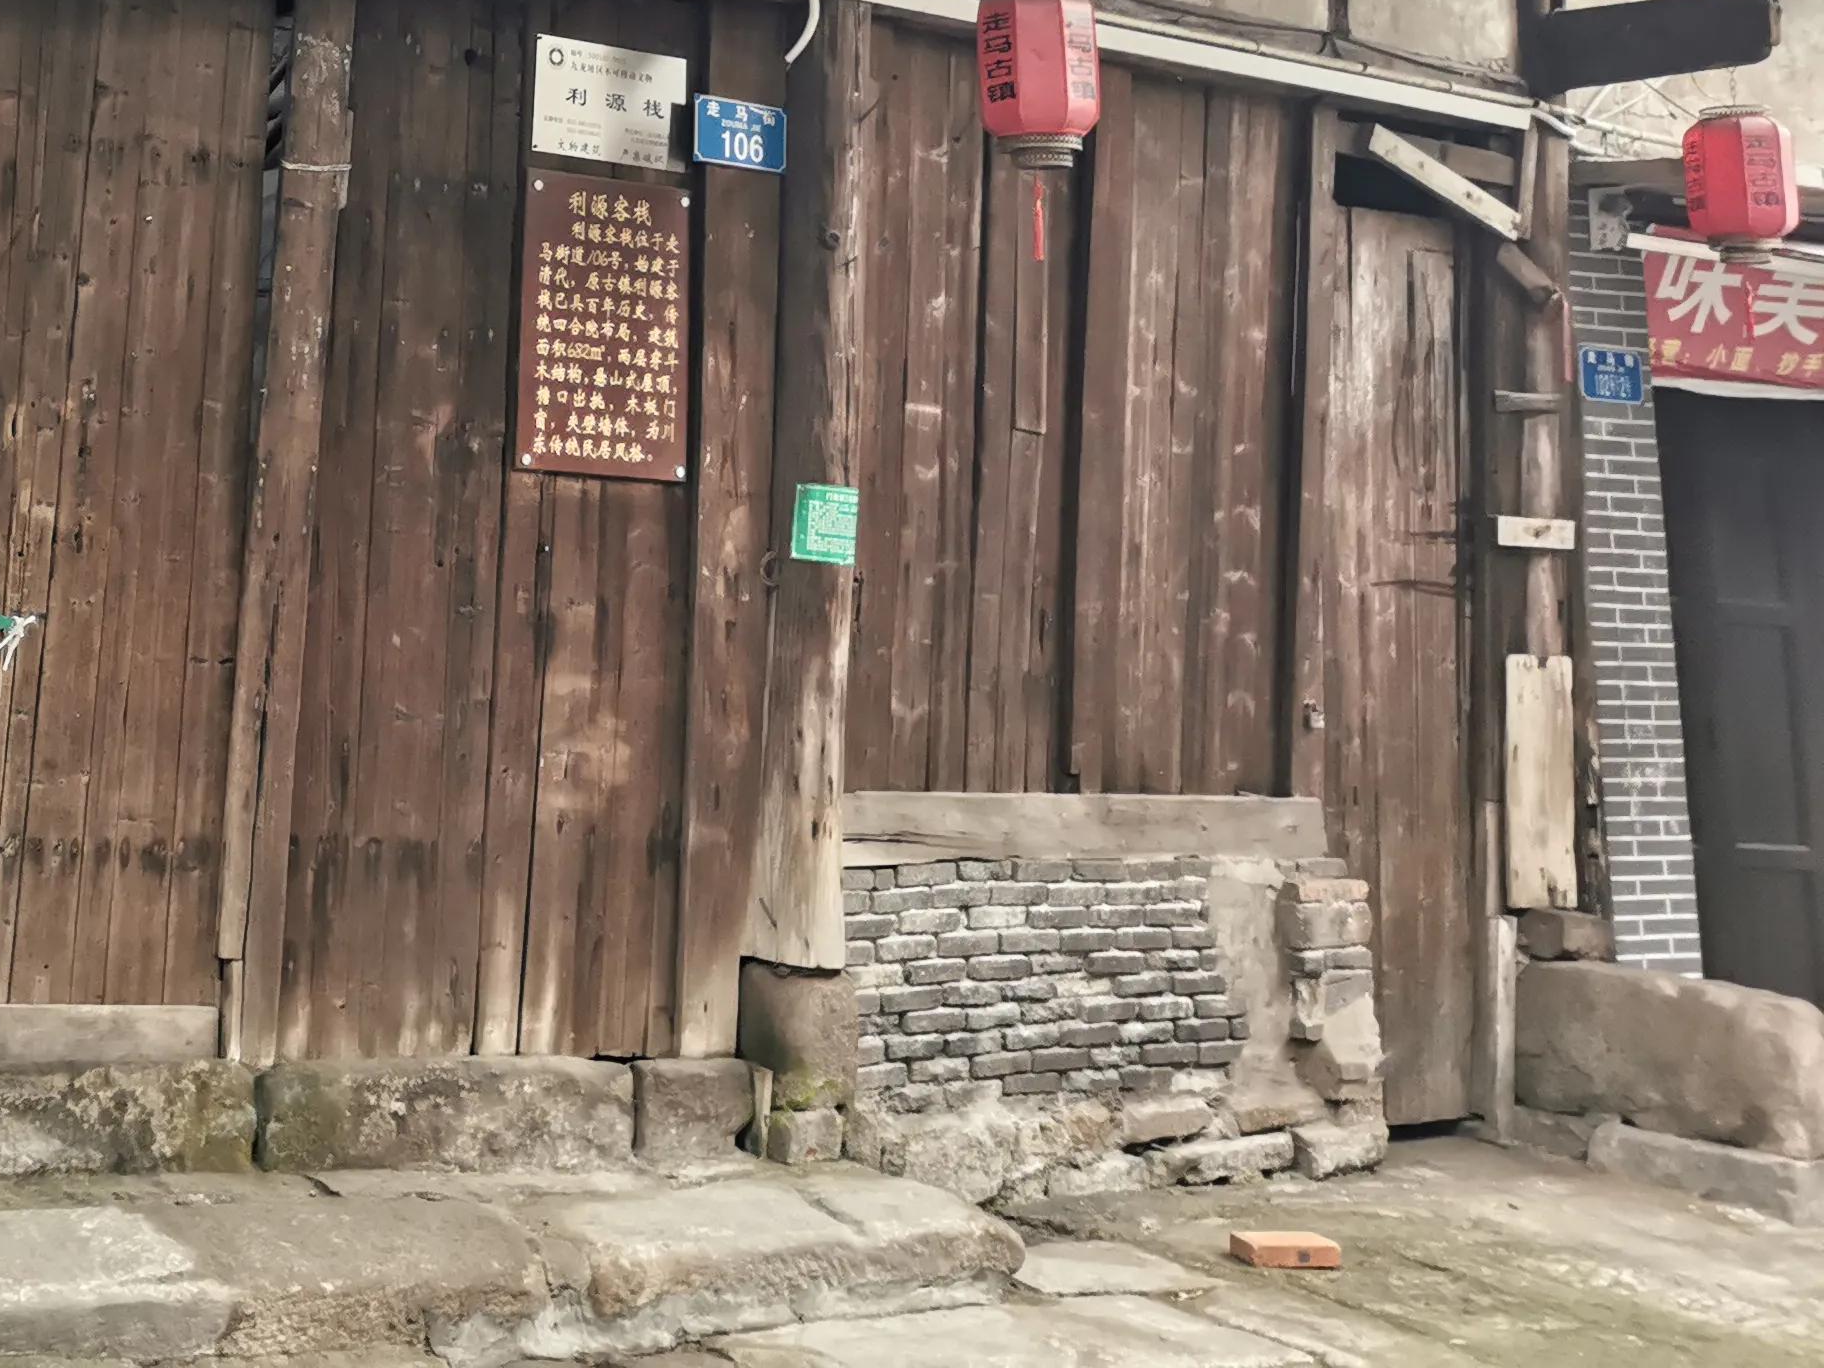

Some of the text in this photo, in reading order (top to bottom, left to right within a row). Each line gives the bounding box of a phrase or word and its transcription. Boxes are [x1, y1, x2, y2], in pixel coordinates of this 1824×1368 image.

[982, 11, 1017, 105] 走马古镇
[565, 88, 665, 119] 利源栈
[706, 101, 776, 126] 走马街
[721, 130, 764, 163] 106
[569, 191, 651, 226] 利源客栈
[572, 221, 680, 254] 利源客栈位于走
